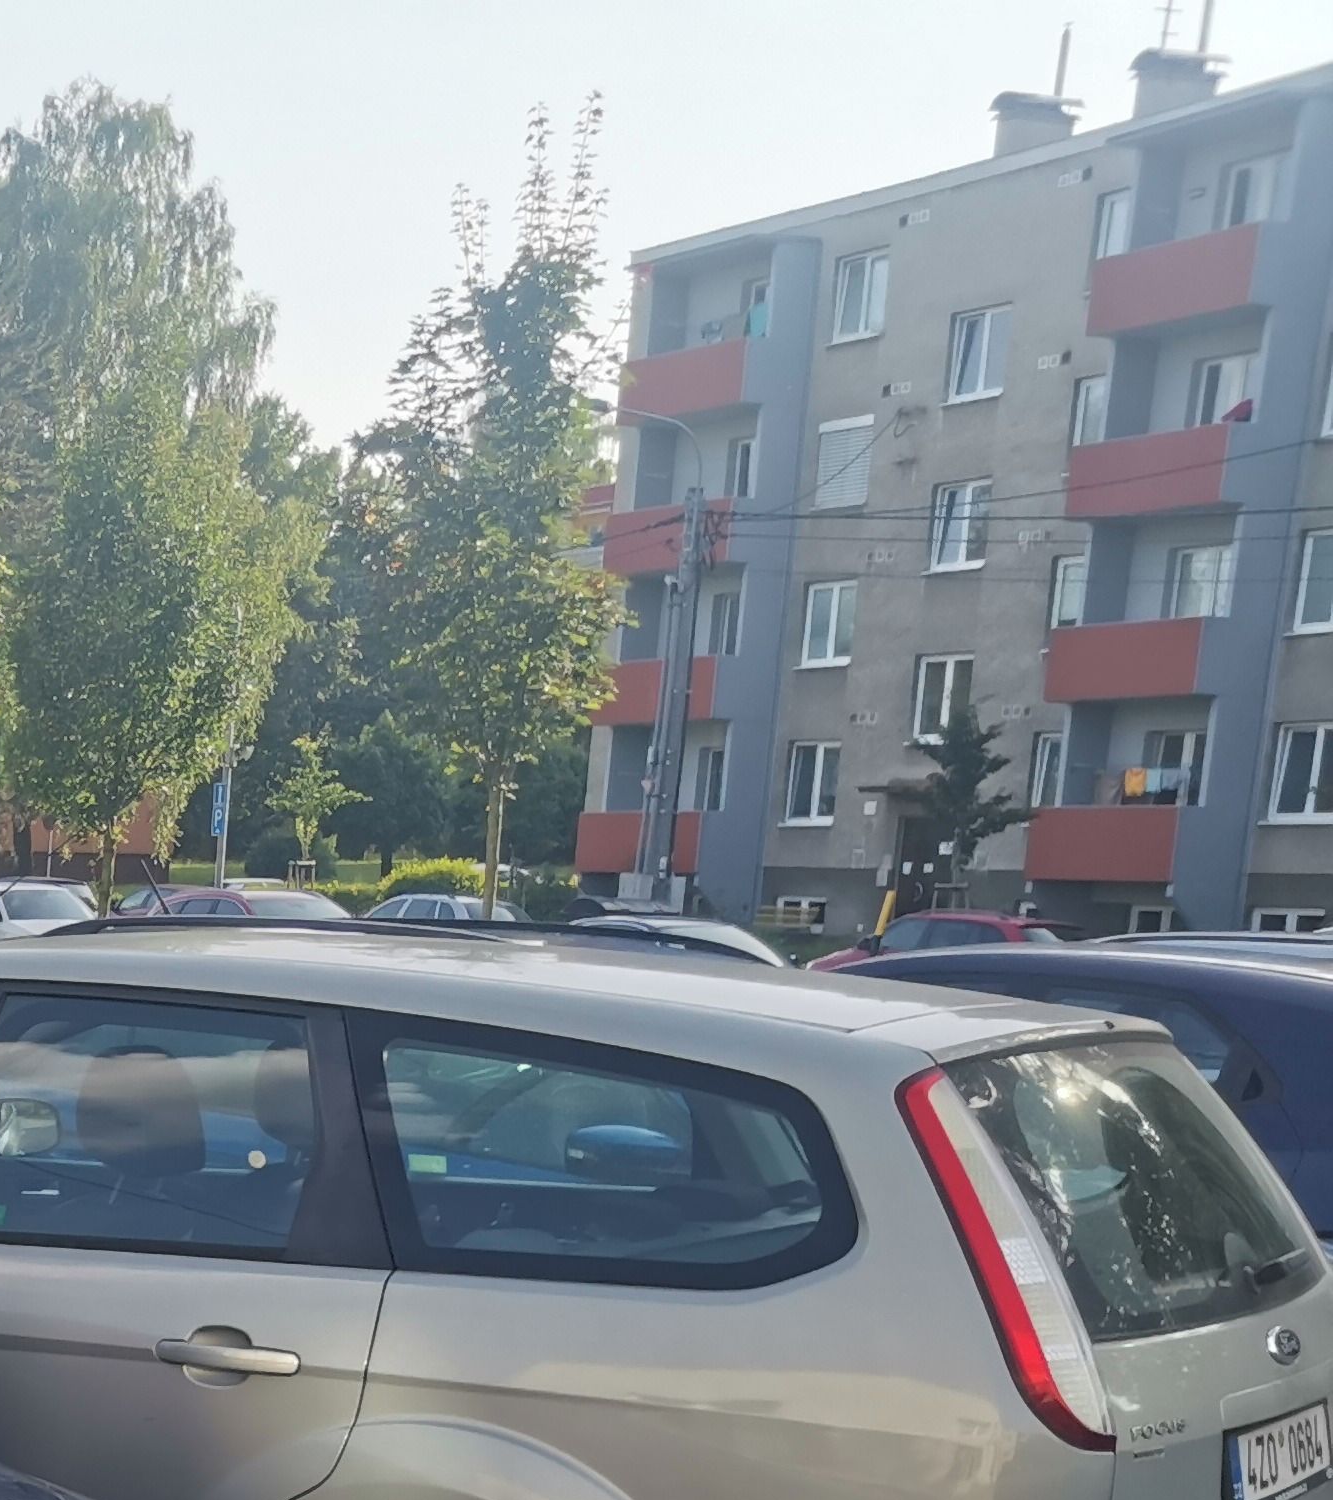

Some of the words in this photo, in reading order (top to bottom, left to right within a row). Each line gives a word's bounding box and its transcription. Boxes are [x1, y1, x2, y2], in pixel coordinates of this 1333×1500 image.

[214, 808, 223, 828] P
[1130, 1418, 1185, 1443] FOCUS
[1288, 1414, 1323, 1475] 0684
